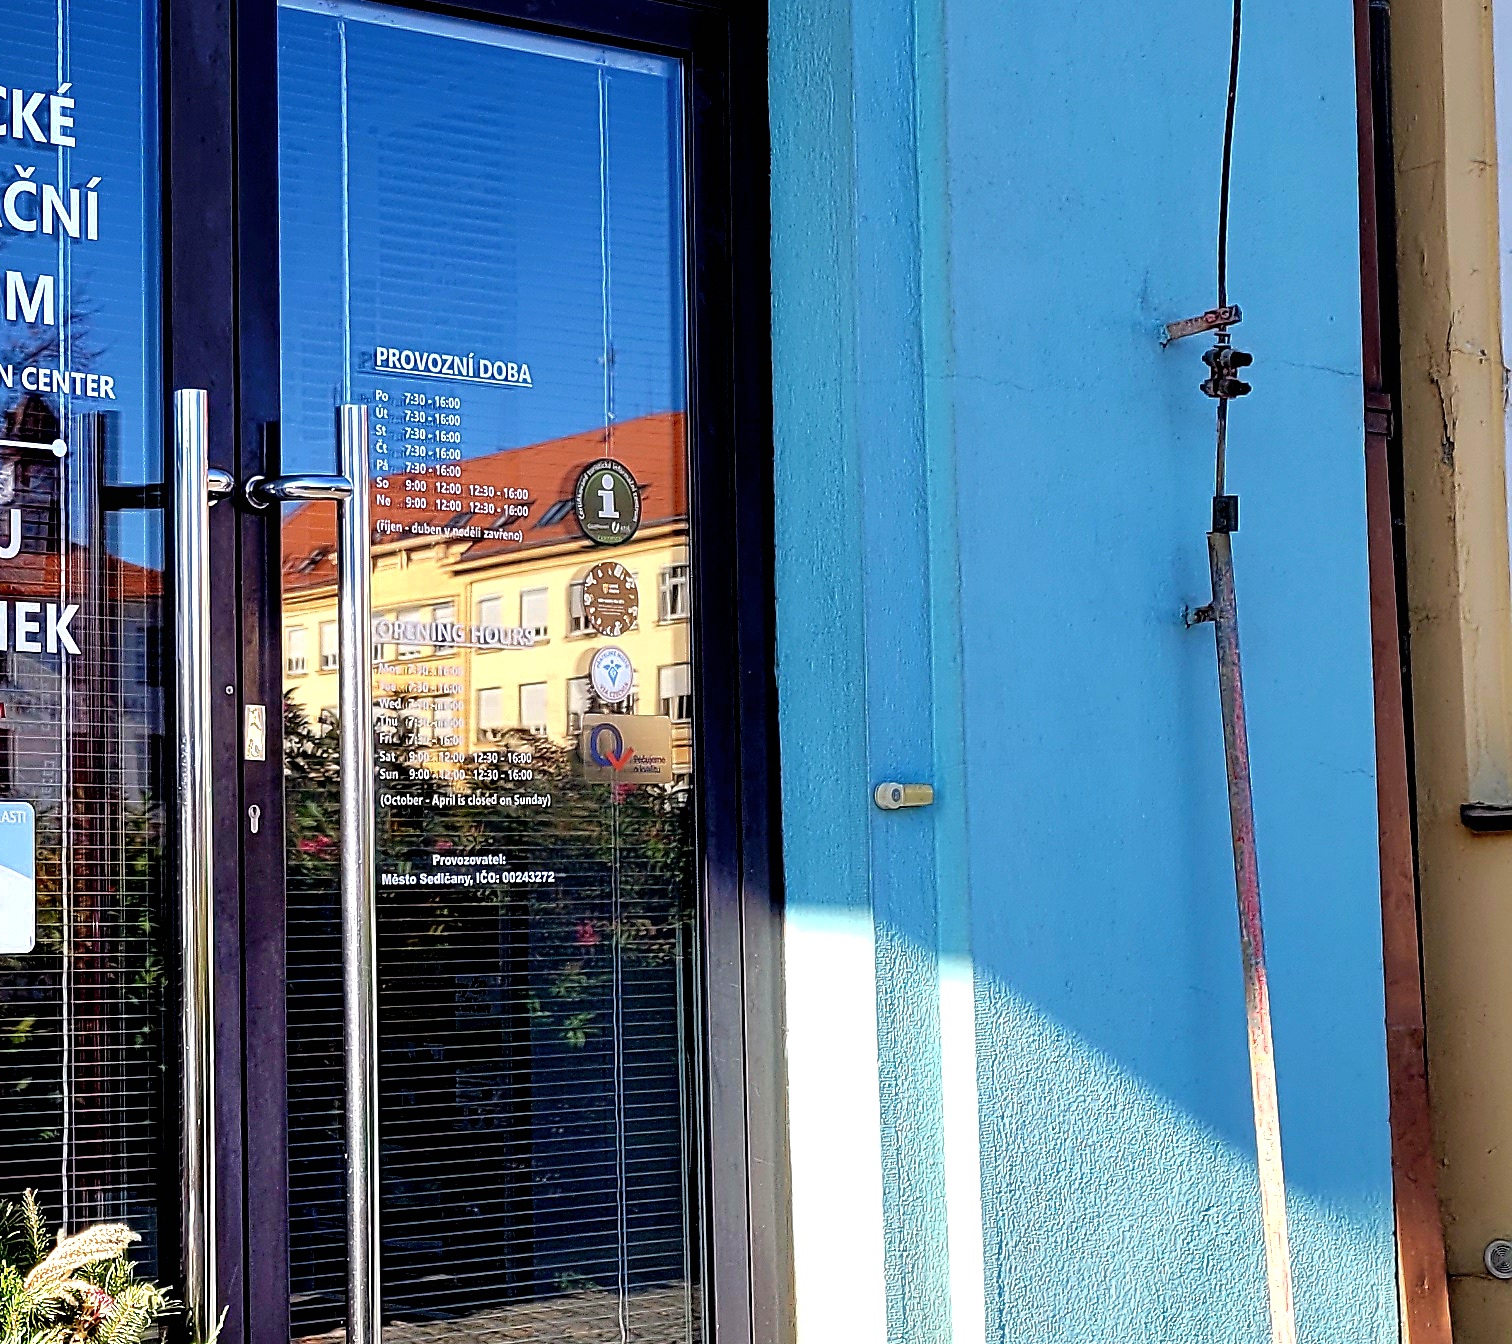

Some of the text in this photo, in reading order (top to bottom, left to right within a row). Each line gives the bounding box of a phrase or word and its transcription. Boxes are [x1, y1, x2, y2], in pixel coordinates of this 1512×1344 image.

[376, 346, 532, 384] PROVOZNÍ DOBA
[21, 366, 116, 400] CENTER
[375, 389, 389, 402] Po
[404, 392, 426, 406] 7:30
[434, 395, 461, 409] 16:00
[375, 404, 389, 419] Út
[405, 409, 426, 423] 7:30
[435, 413, 461, 426] 16:00
[375, 424, 387, 437] St
[405, 426, 426, 440] 7:30
[435, 430, 461, 443] 16:00
[405, 444, 426, 457] 7:30
[435, 447, 461, 460] 16:00
[405, 461, 426, 475] 7:30
[435, 464, 462, 478] 16:00
[376, 476, 390, 489] So
[405, 479, 427, 492] 9:00
[435, 482, 462, 495] 12:00
[469, 484, 495, 498] 12:30
[503, 487, 529, 500] 16:00
[405, 496, 427, 509] 9:00
[435, 499, 462, 512] 12:00
[469, 501, 495, 515] 12:30
[503, 504, 529, 517] 16:00
[411, 522, 442, 536] duben
[483, 529, 523, 544] zavřeno)
[375, 619, 535, 646] OPENING HOURS
[379, 697, 402, 709] Wed
[379, 715, 398, 727] Thu
[379, 733, 393, 744] Fri
[379, 751, 396, 763] Sat
[408, 752, 430, 763] 9:00
[439, 752, 465, 764] 12:00
[473, 752, 498, 764] 12:30
[507, 752, 532, 764] 16:00
[379, 769, 399, 780] Sun
[408, 769, 430, 780] 9:00
[439, 769, 465, 780] 12:00
[473, 769, 499, 781] 12:30
[507, 769, 533, 781] 16:00
[380, 794, 424, 807] (October
[431, 794, 456, 808] April
[457, 795, 466, 806] is
[467, 794, 498, 807] closed
[499, 796, 512, 807] on
[513, 794, 552, 808] Sunday)
[432, 853, 507, 866] Provozovatel:
[381, 870, 556, 887] Město Sedlčany, IČO: 00243272
